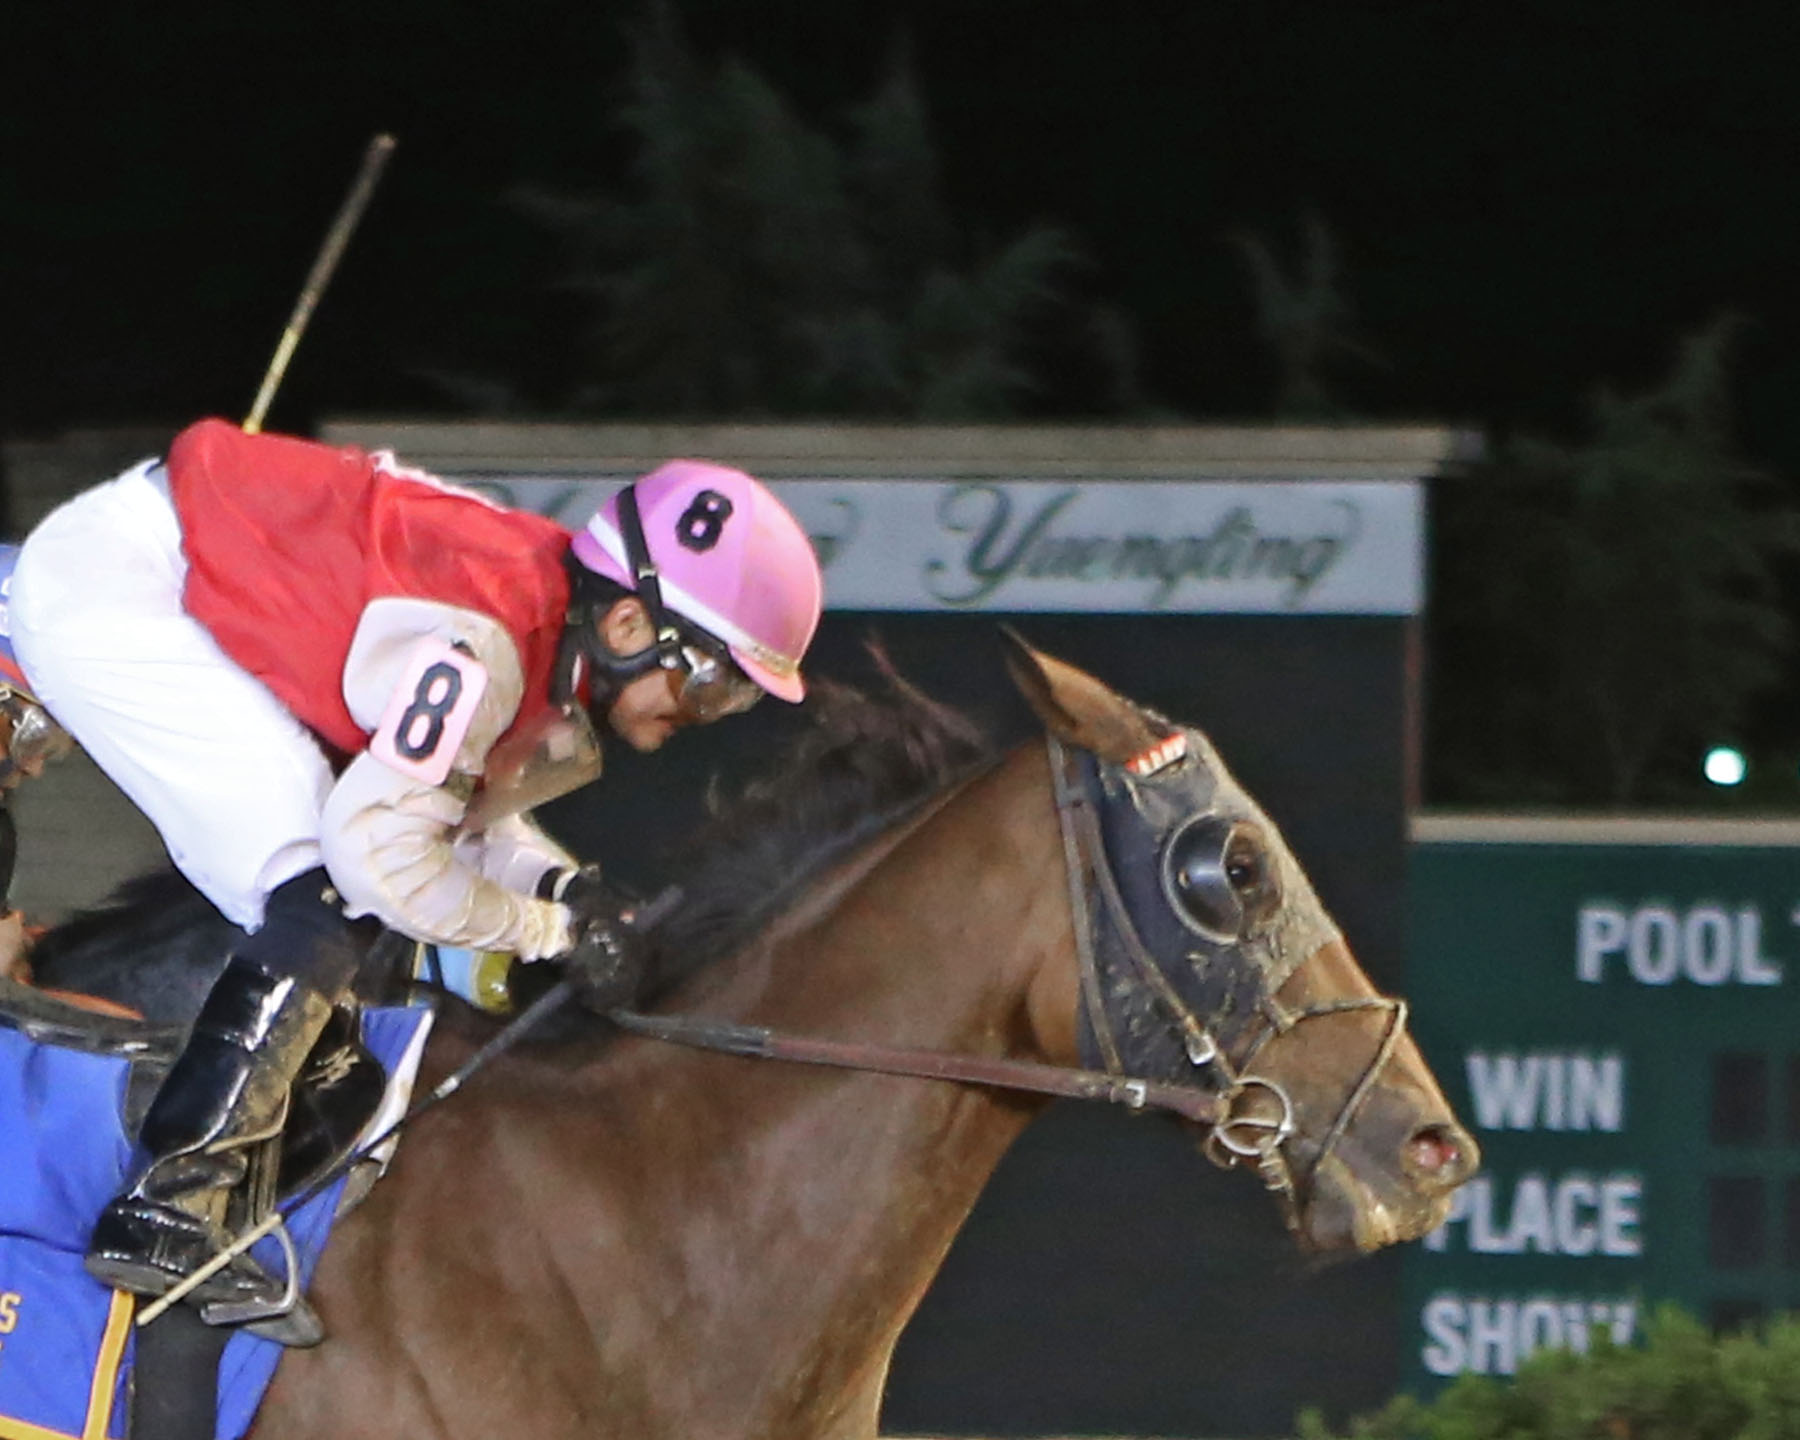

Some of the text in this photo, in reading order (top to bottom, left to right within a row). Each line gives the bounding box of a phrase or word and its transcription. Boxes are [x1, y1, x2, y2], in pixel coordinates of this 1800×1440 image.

[674, 489, 734, 554] 8
[395, 660, 464, 763] 8
[1576, 906, 1781, 986] POOL
[1465, 1053, 1624, 1132] WIN
